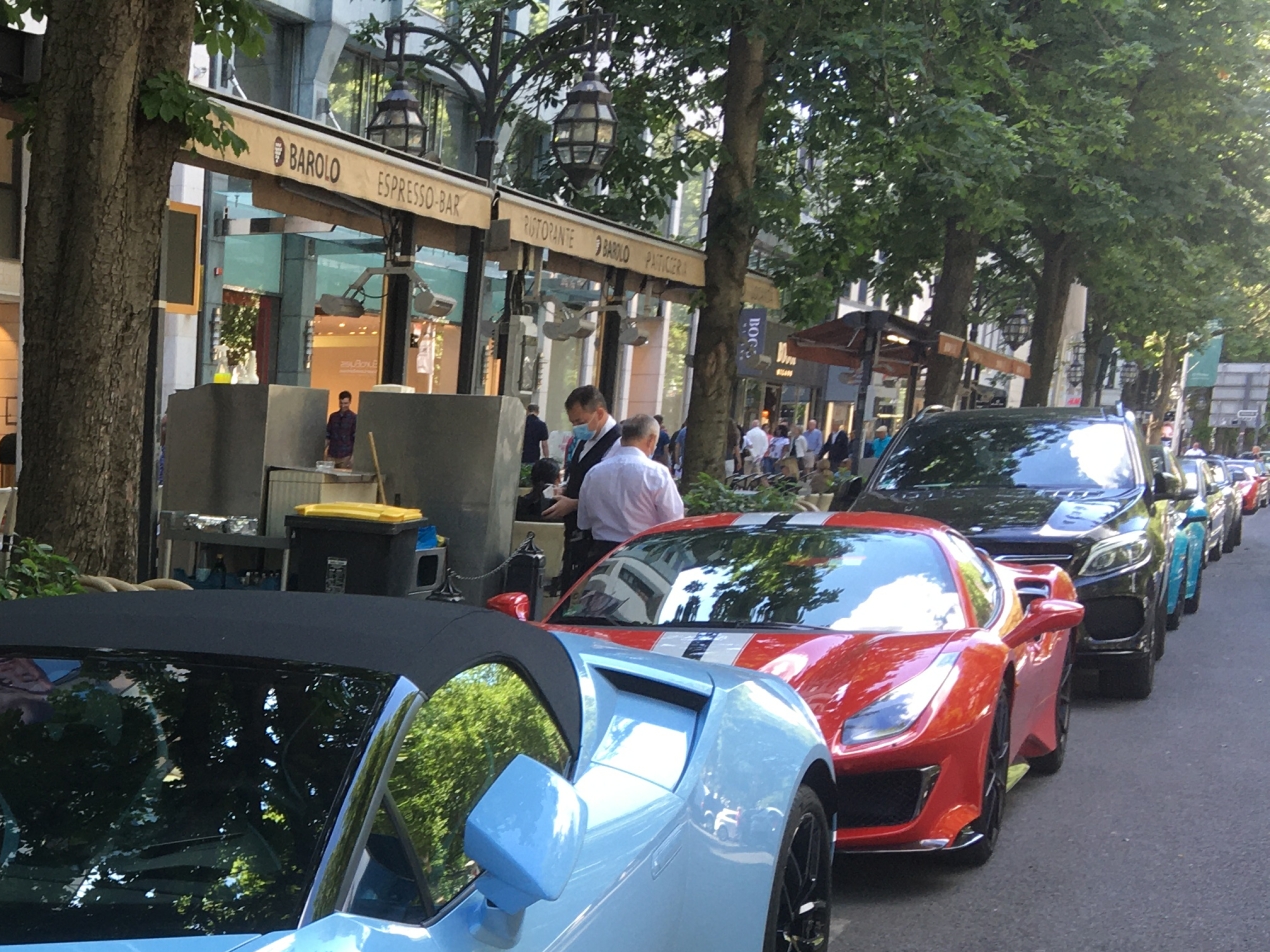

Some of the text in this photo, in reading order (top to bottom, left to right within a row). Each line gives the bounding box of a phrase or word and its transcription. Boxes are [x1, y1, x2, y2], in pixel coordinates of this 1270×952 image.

[289, 142, 461, 217] BAROLO ESPRESSO-BAR
[602, 238, 630, 264] BAROLO
